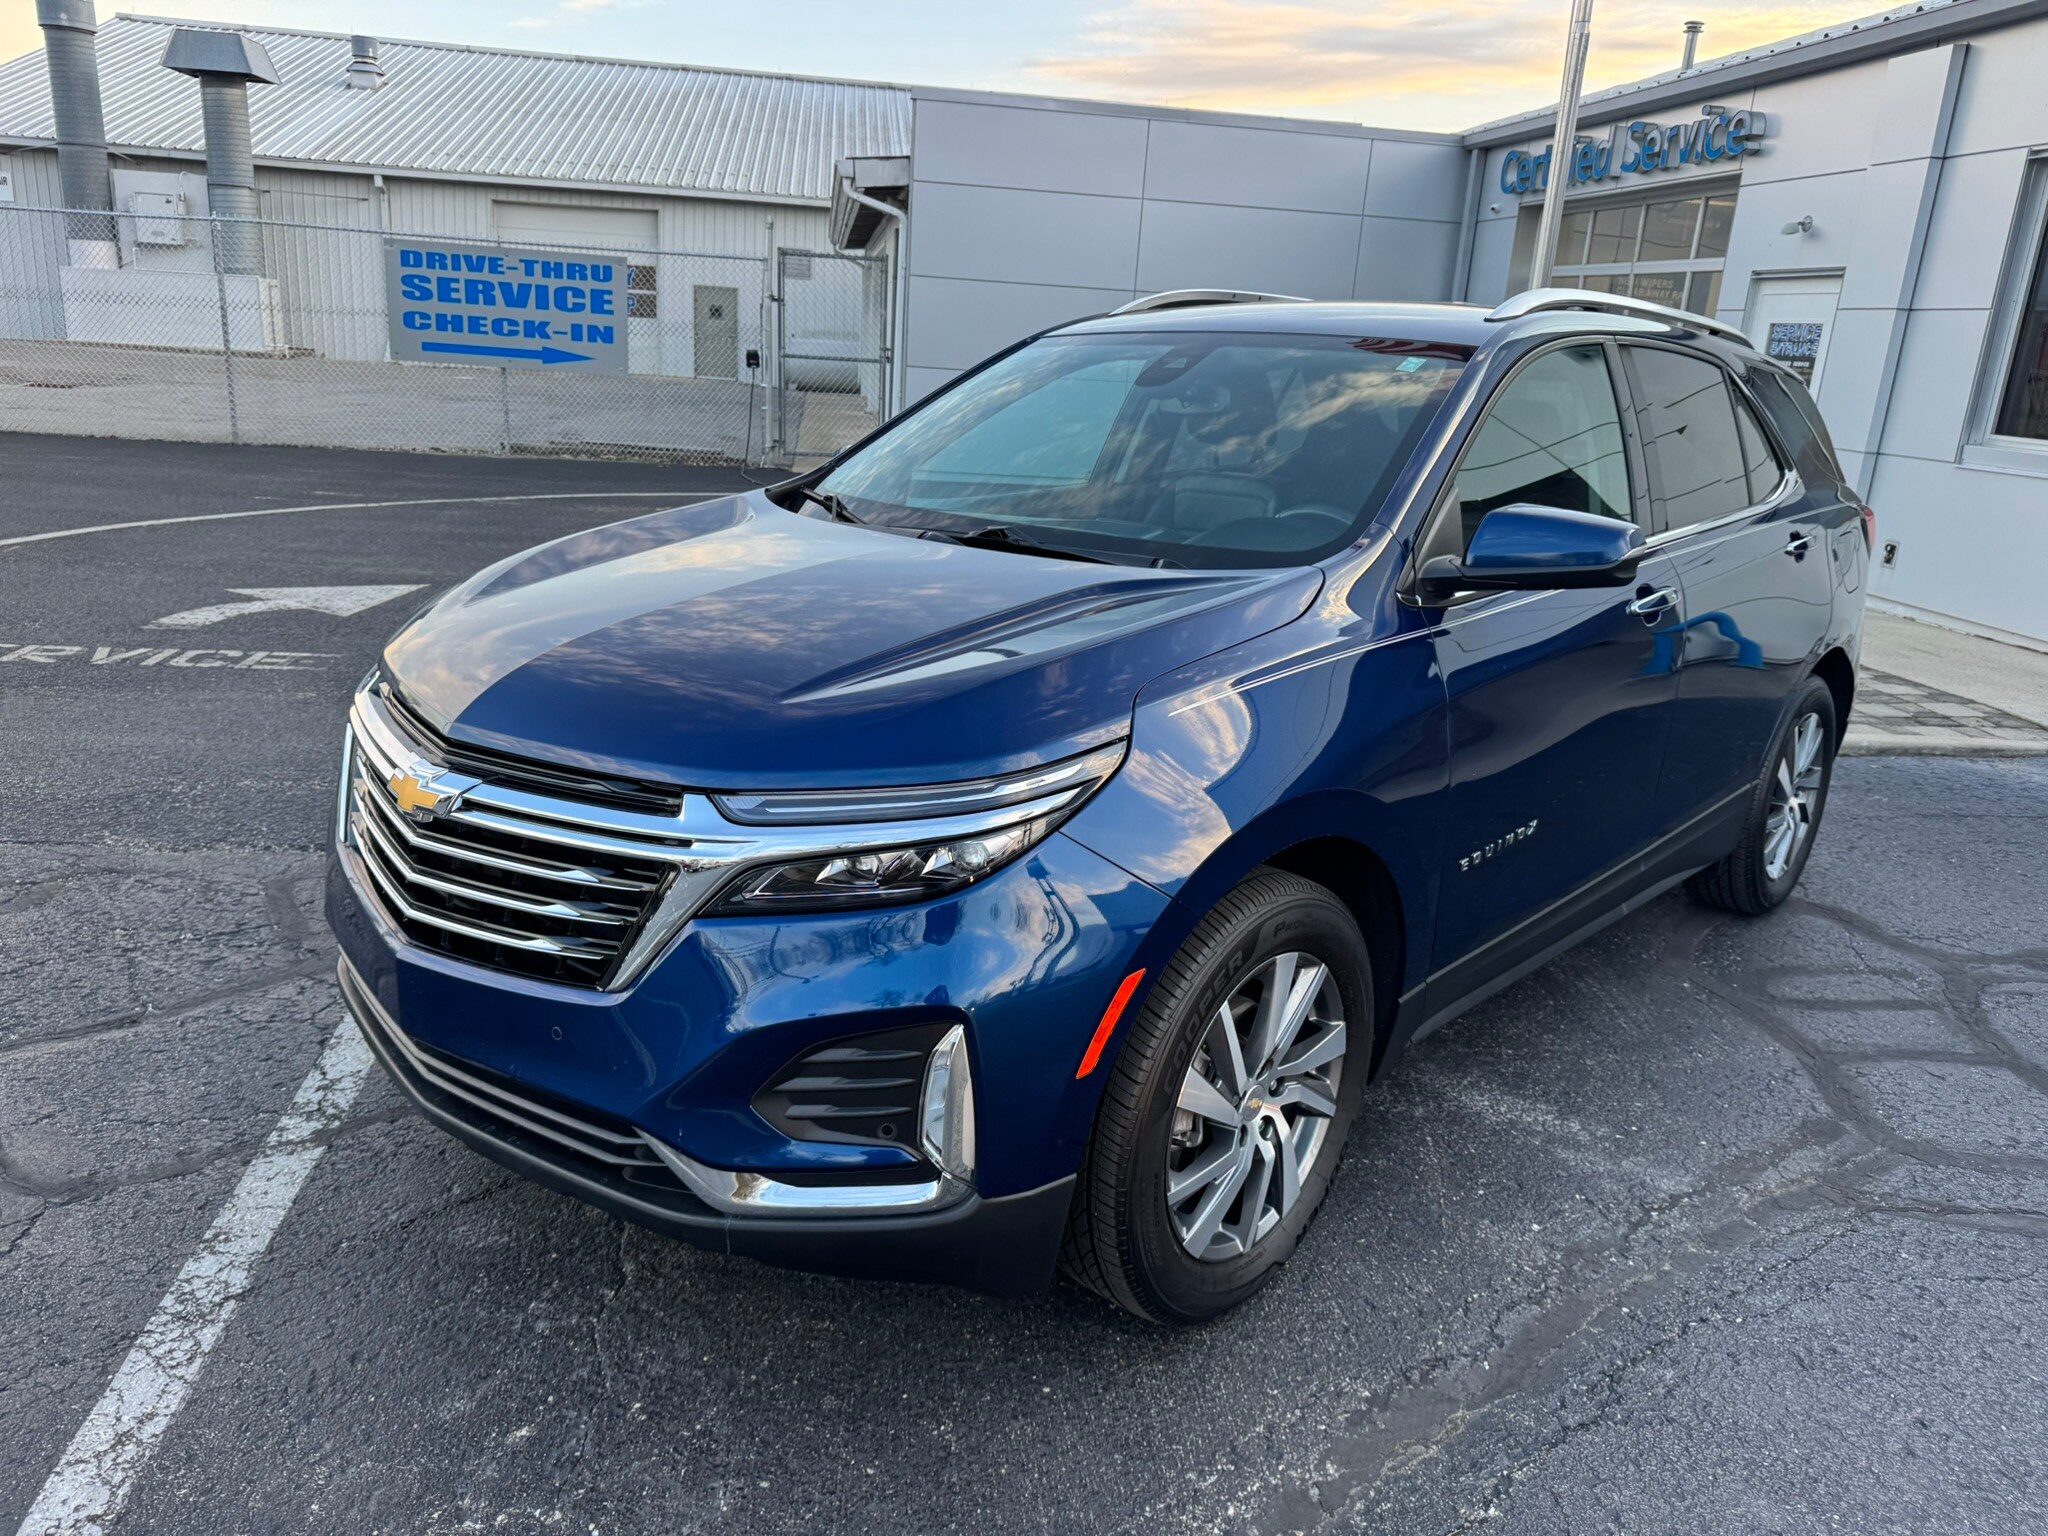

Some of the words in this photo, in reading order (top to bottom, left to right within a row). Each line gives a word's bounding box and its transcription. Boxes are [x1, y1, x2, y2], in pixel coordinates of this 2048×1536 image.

[1501, 124, 1618, 194] Certied
[1621, 104, 1756, 172] Service
[400, 249, 613, 283] DRIVE-THRU
[401, 274, 614, 315] SERVICE
[1641, 277, 1674, 289] WIPERS
[1645, 288, 1671, 299] AWAY
[402, 311, 614, 344] CHECK-IN
[1772, 324, 1821, 341] SERVICE
[1769, 341, 1819, 358] ENTRANCE
[0, 643, 346, 671] RVICE
[1459, 819, 1538, 872] EQUINOX
[1163, 950, 1244, 1095] COOPER
